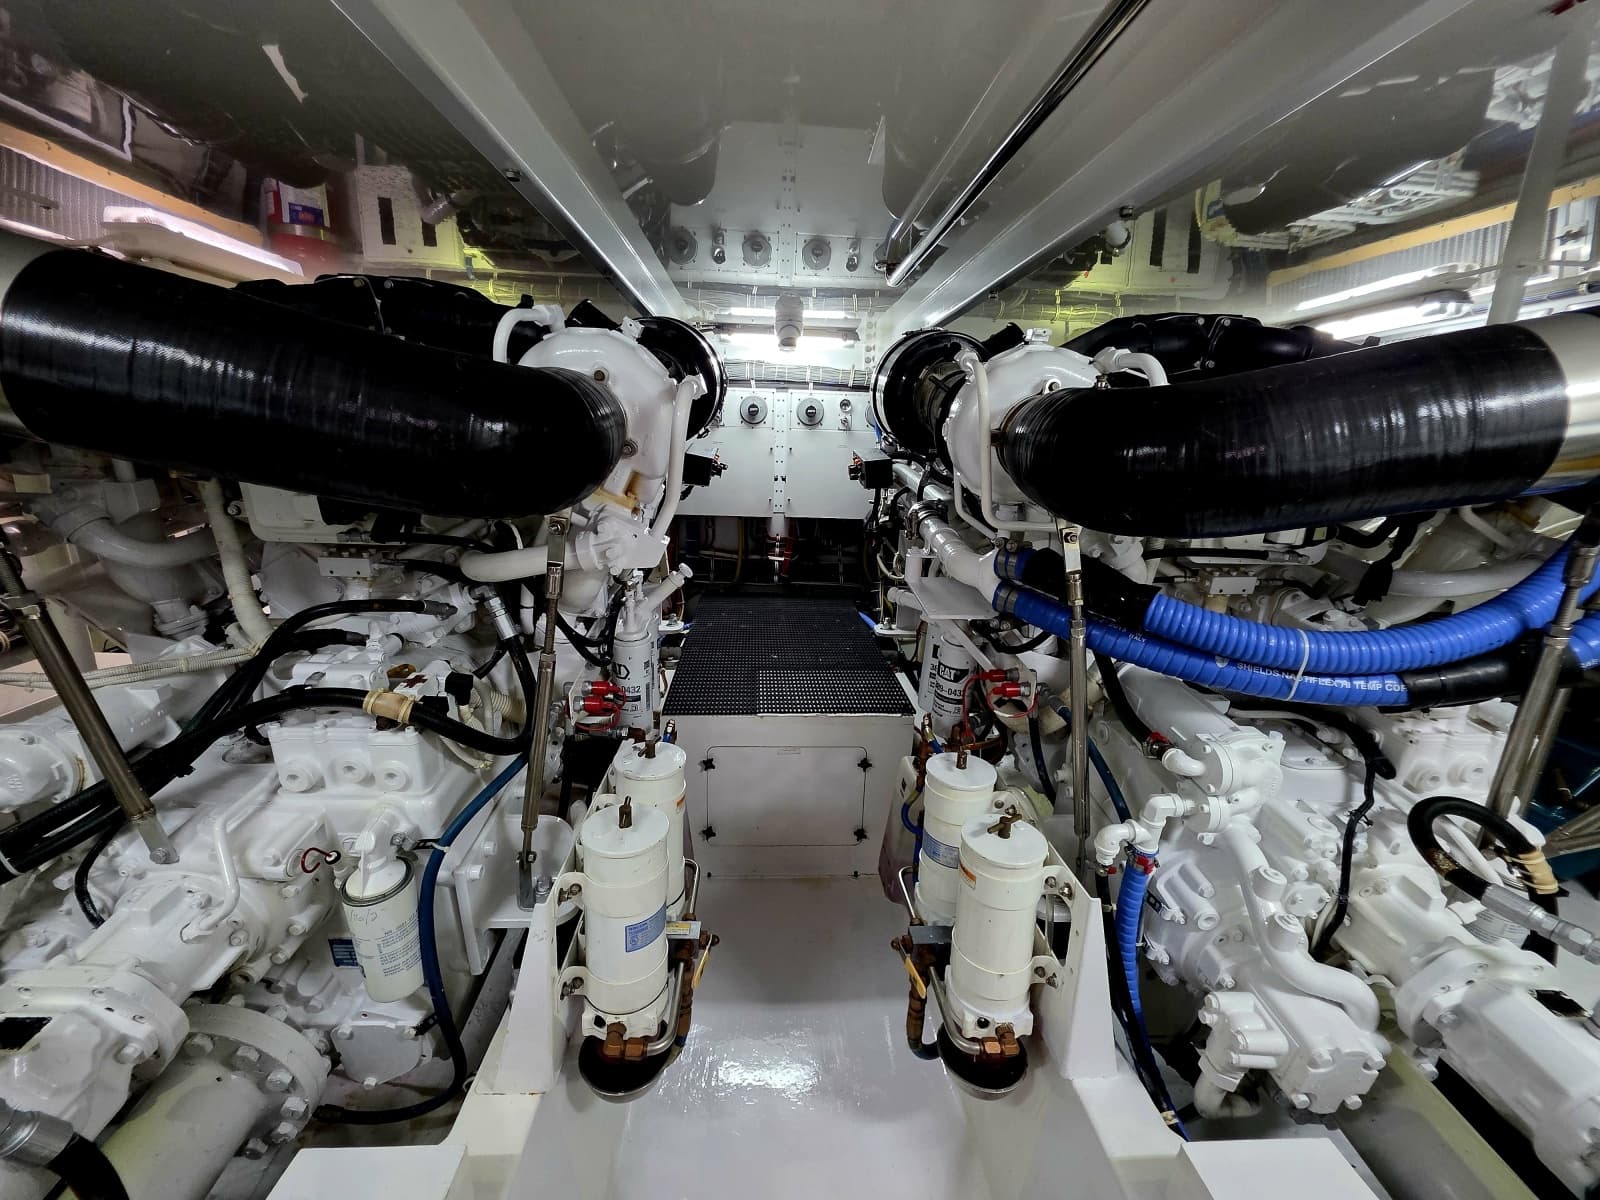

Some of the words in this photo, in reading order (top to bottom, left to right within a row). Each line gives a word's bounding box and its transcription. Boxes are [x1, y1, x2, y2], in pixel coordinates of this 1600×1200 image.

[939, 665, 957, 681] CAT
[1236, 662, 1279, 677] SHIELDS
[1353, 679, 1382, 691] TEMP
